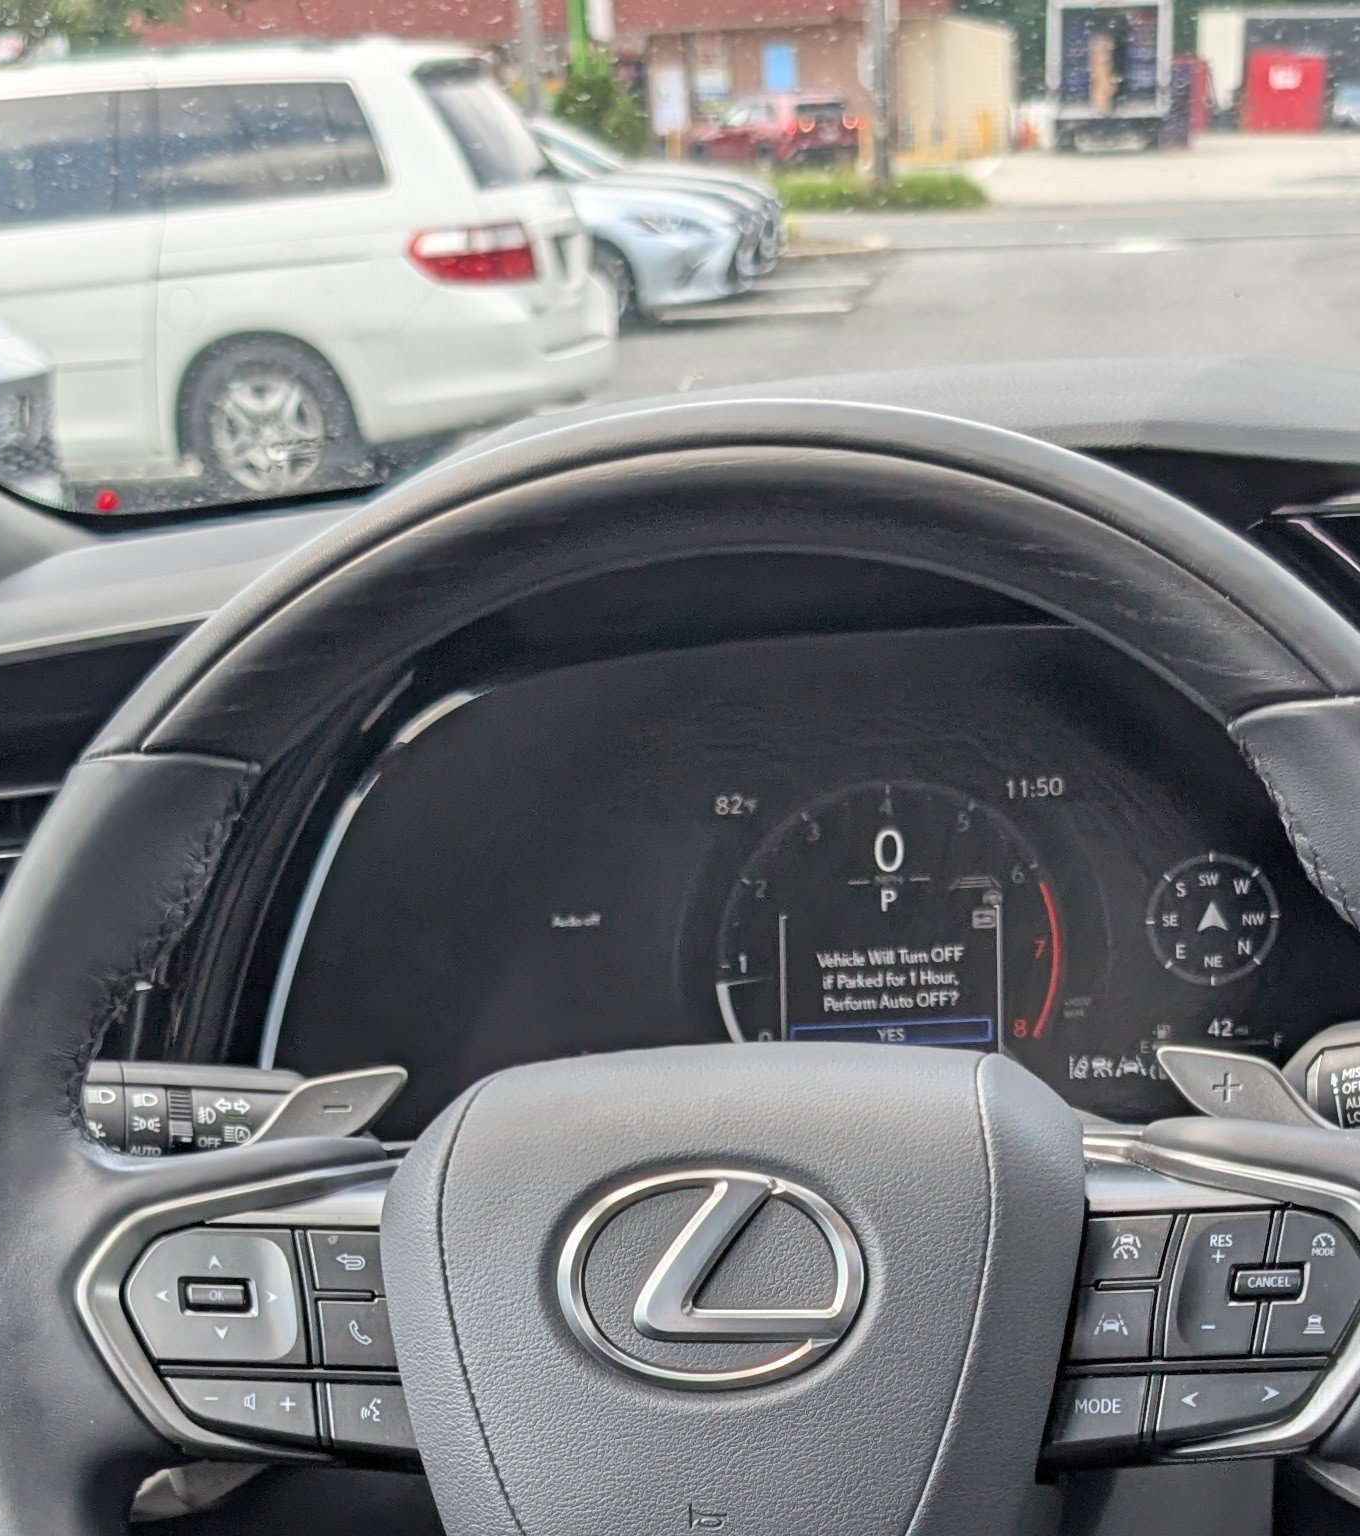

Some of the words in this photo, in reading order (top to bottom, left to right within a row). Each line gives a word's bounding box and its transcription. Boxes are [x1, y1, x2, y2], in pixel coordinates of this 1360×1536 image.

[1006, 776, 1065, 799] 11:50
[874, 828, 905, 873] 0
[1198, 873, 1220, 887] SW
[1232, 878, 1252, 896] W
[1175, 882, 1188, 898] S
[880, 889, 897, 912] P
[1161, 913, 1180, 928] SE
[1241, 913, 1265, 927] NW
[1175, 943, 1187, 960] E
[1237, 939, 1253, 956] N
[816, 949, 866, 968] Vehicle
[868, 949, 896, 966] Will
[897, 947, 930, 964] Turn
[931, 945, 965, 963] OFF
[1203, 955, 1224, 969] NE
[836, 970, 884, 989] Parked
[885, 971, 906, 988] for
[823, 994, 878, 1012] Perform
[879, 992, 915, 1010] Auto
[915, 990, 961, 1008] OFF?
[877, 1028, 906, 1042] YES
[1207, 1018, 1234, 1038] 42
[130, 1144, 162, 1157] AUTO
[197, 1136, 222, 1149] OFF
[1208, 1234, 1233, 1248] RES
[1310, 1247, 1336, 1257] MODE
[1247, 1276, 1291, 1289] CANCEL
[209, 1289, 225, 1302] OK
[1073, 1398, 1122, 1414] MODE
